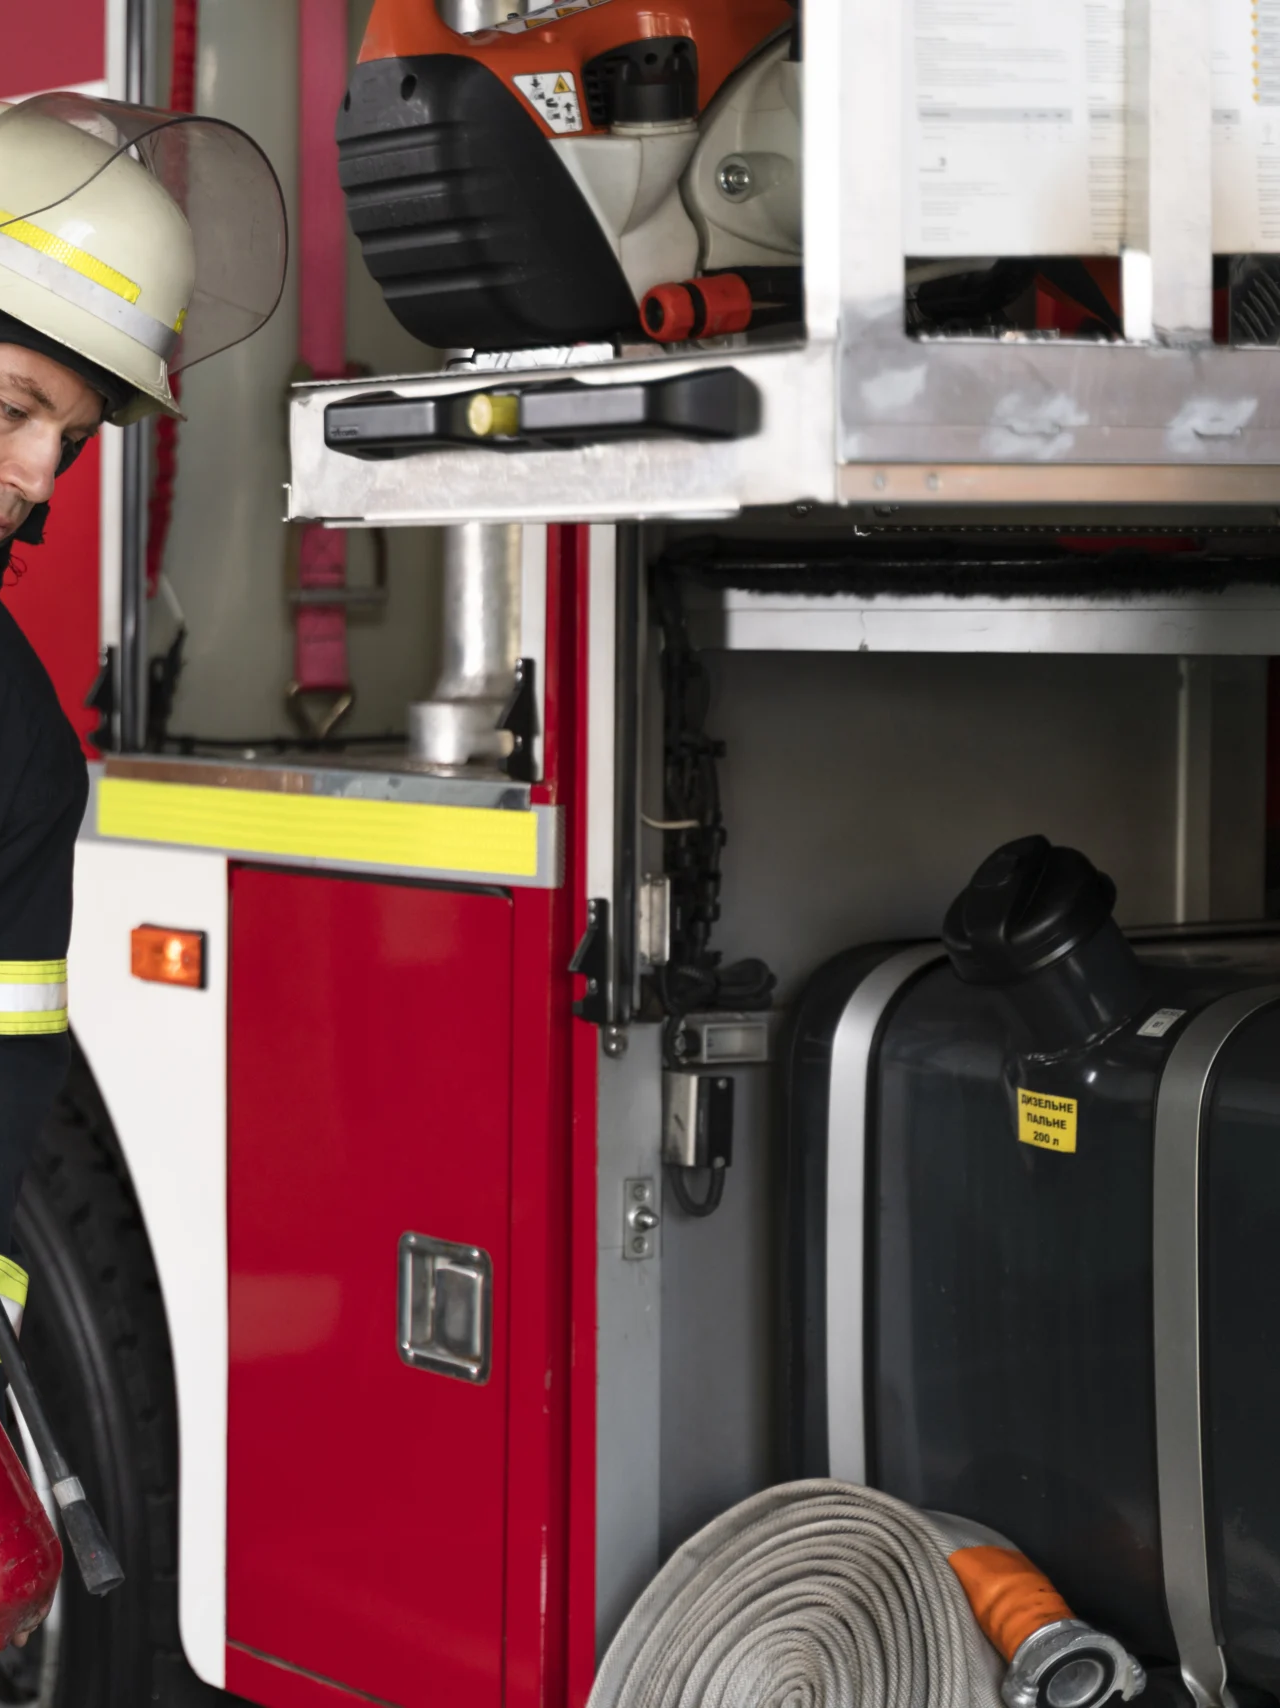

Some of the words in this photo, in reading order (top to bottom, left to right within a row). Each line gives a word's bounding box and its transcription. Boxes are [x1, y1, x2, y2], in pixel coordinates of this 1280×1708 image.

[1021, 1094, 1074, 1113] ДИЗЕЛЬНЕ
[1026, 1112, 1067, 1130] ПАЛЬНЕ
[1033, 1131, 1050, 1143] 200
